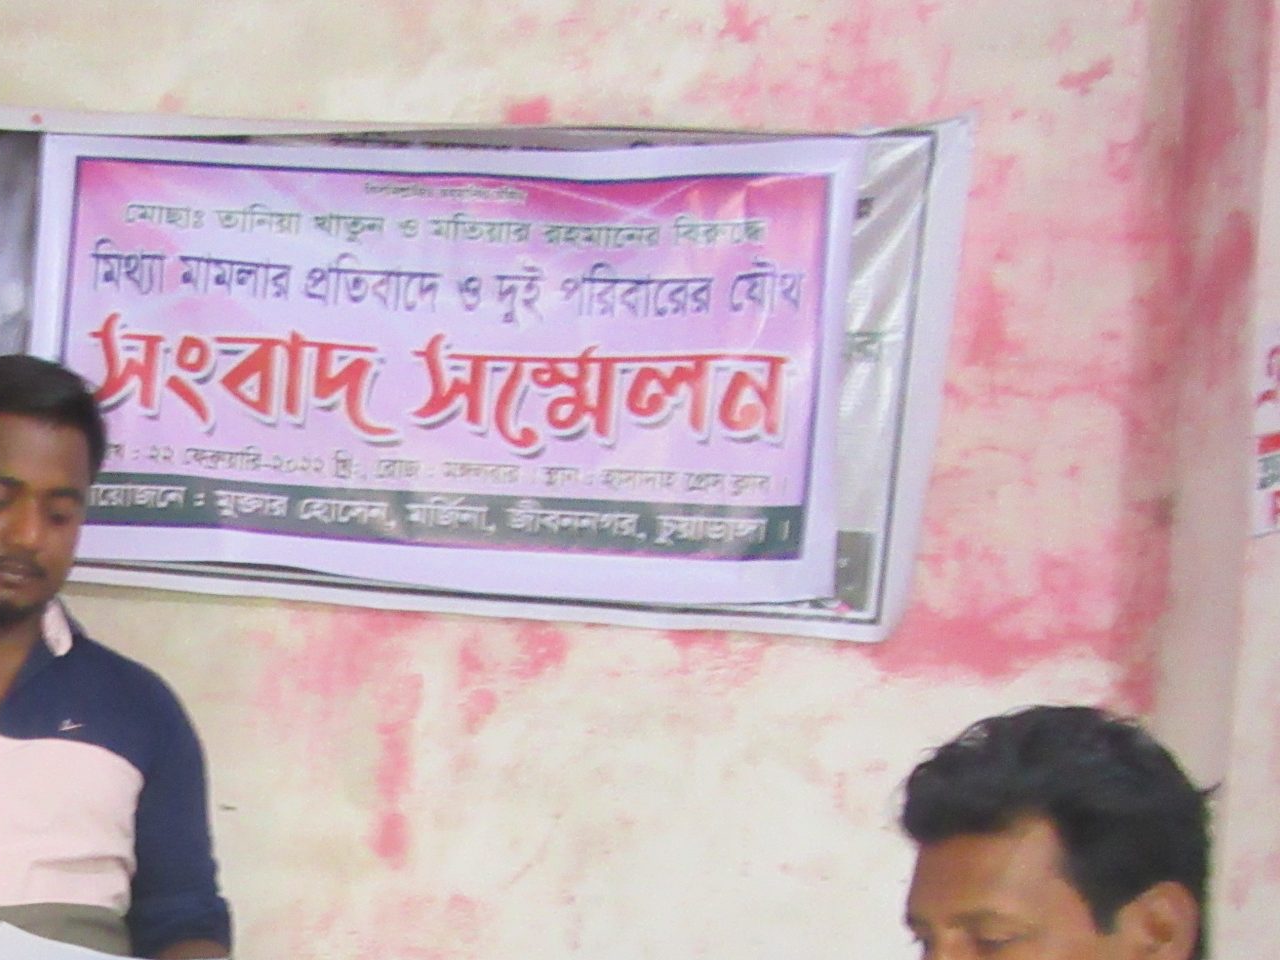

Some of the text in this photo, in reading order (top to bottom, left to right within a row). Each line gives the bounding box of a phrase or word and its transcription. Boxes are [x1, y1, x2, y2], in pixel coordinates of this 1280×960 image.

[215, 203, 301, 235] তানিয়া
[313, 211, 385, 243] খাতুন
[397, 216, 419, 240] ও
[543, 221, 660, 248] রহমানের
[91, 238, 804, 326] মিথ্যা মামলার প্রতিবাদে ও দুই পরিবারের যৌথ
[88, 312, 792, 455] সংবাদ সম্মেলন
